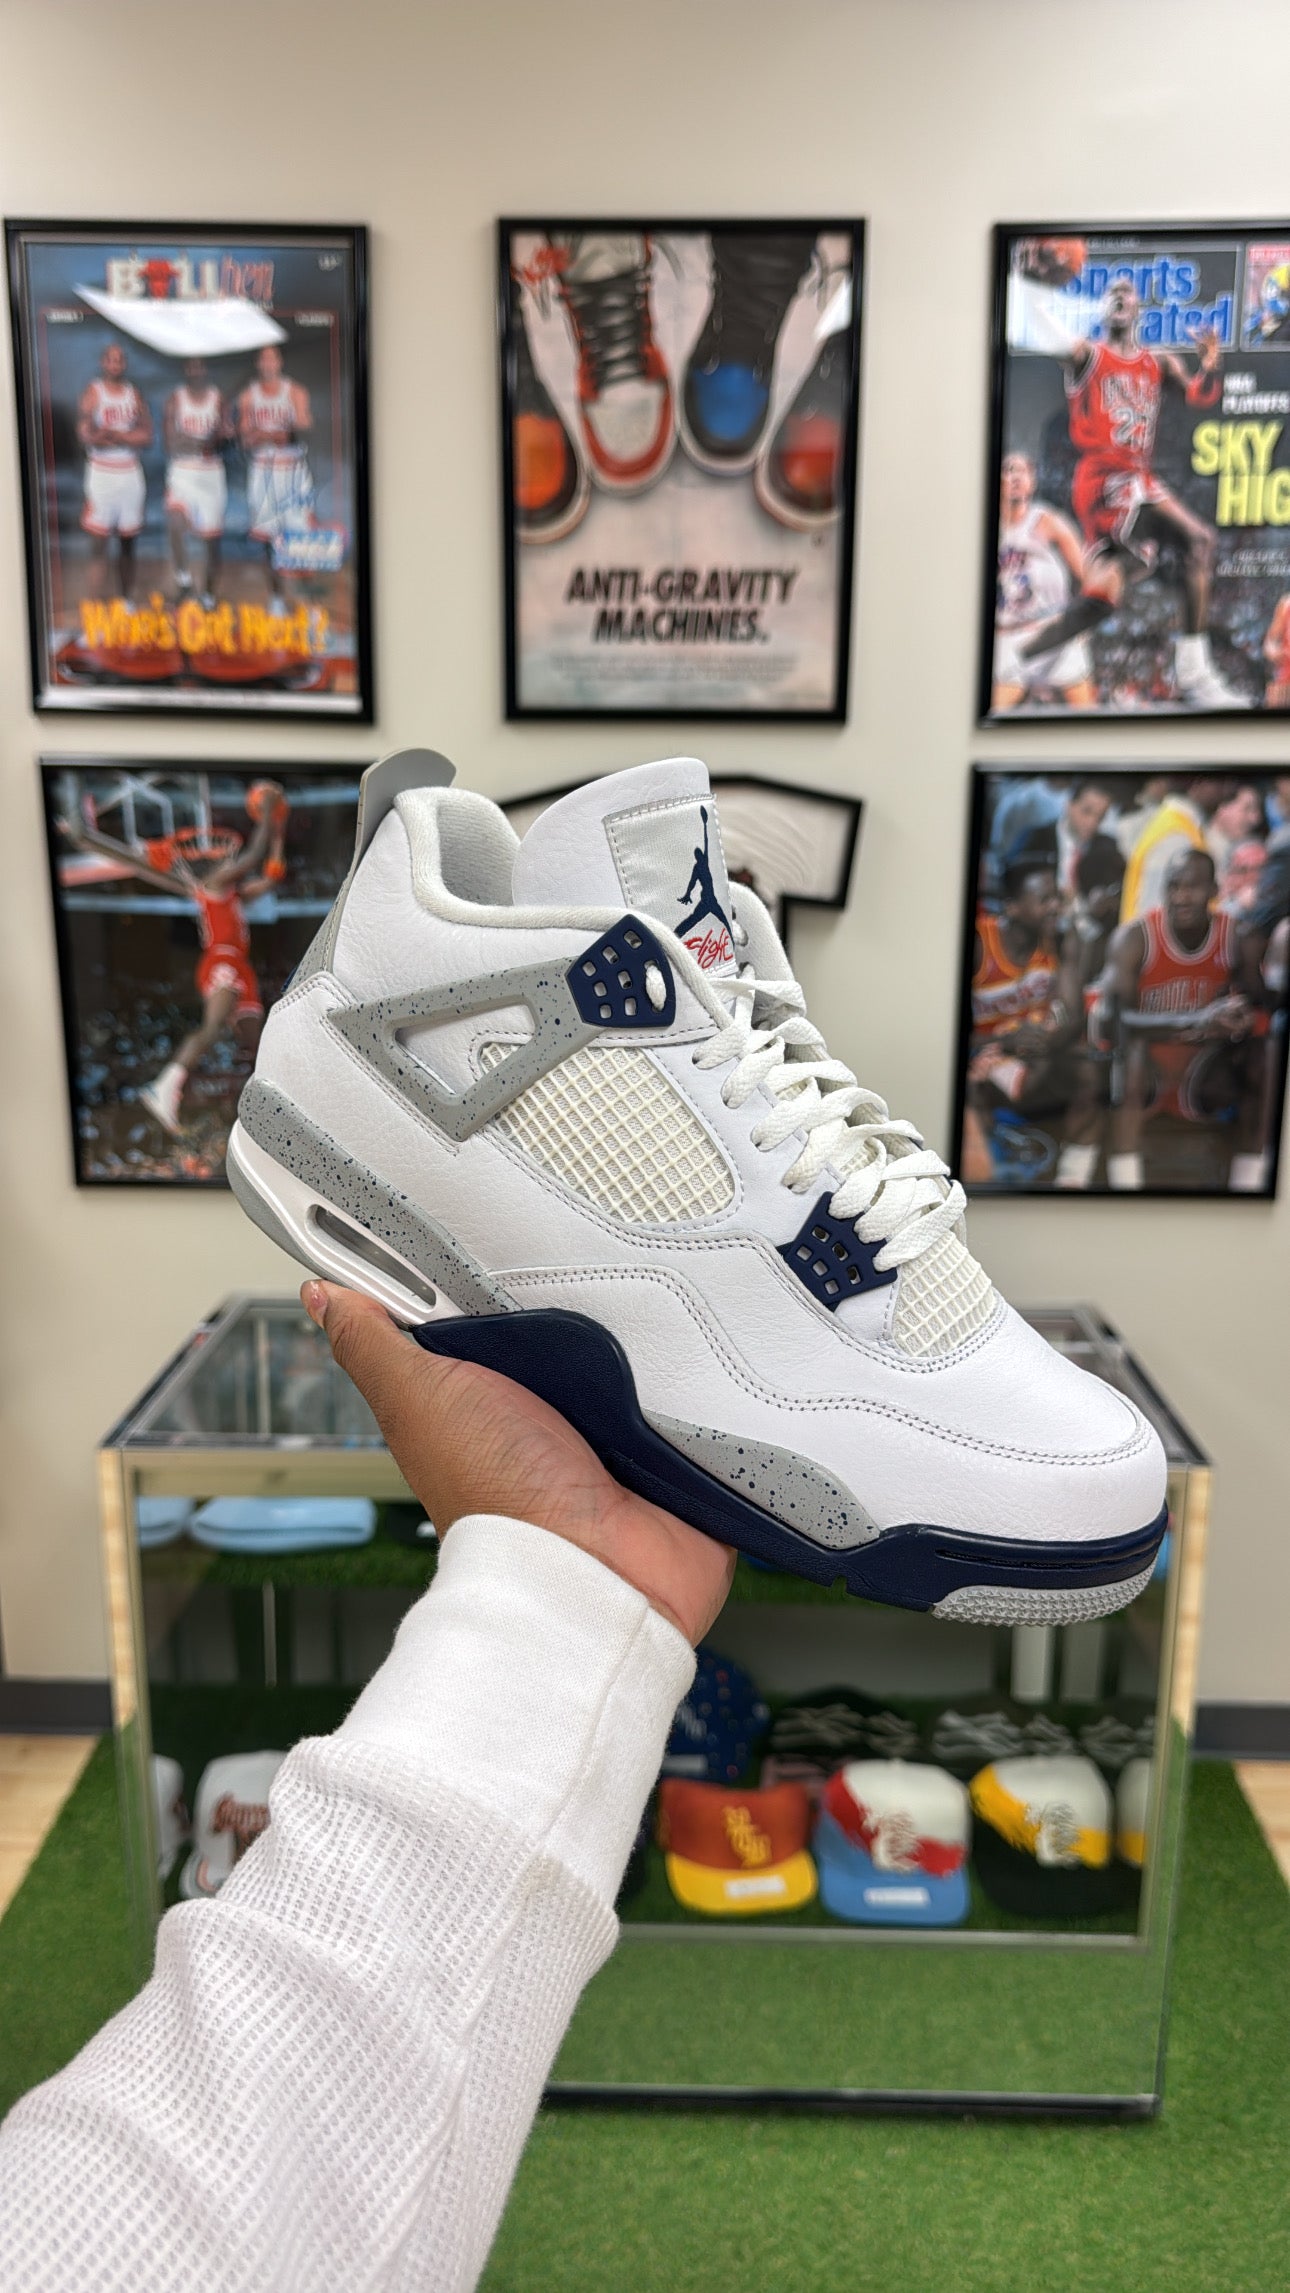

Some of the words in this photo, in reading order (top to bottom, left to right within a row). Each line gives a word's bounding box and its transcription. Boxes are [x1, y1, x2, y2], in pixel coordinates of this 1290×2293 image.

[1191, 419, 1283, 476] SKY
[565, 566, 799, 603] ANTI-GRAVITY
[177, 599, 237, 656] Got
[591, 607, 770, 643] MACHINES.
